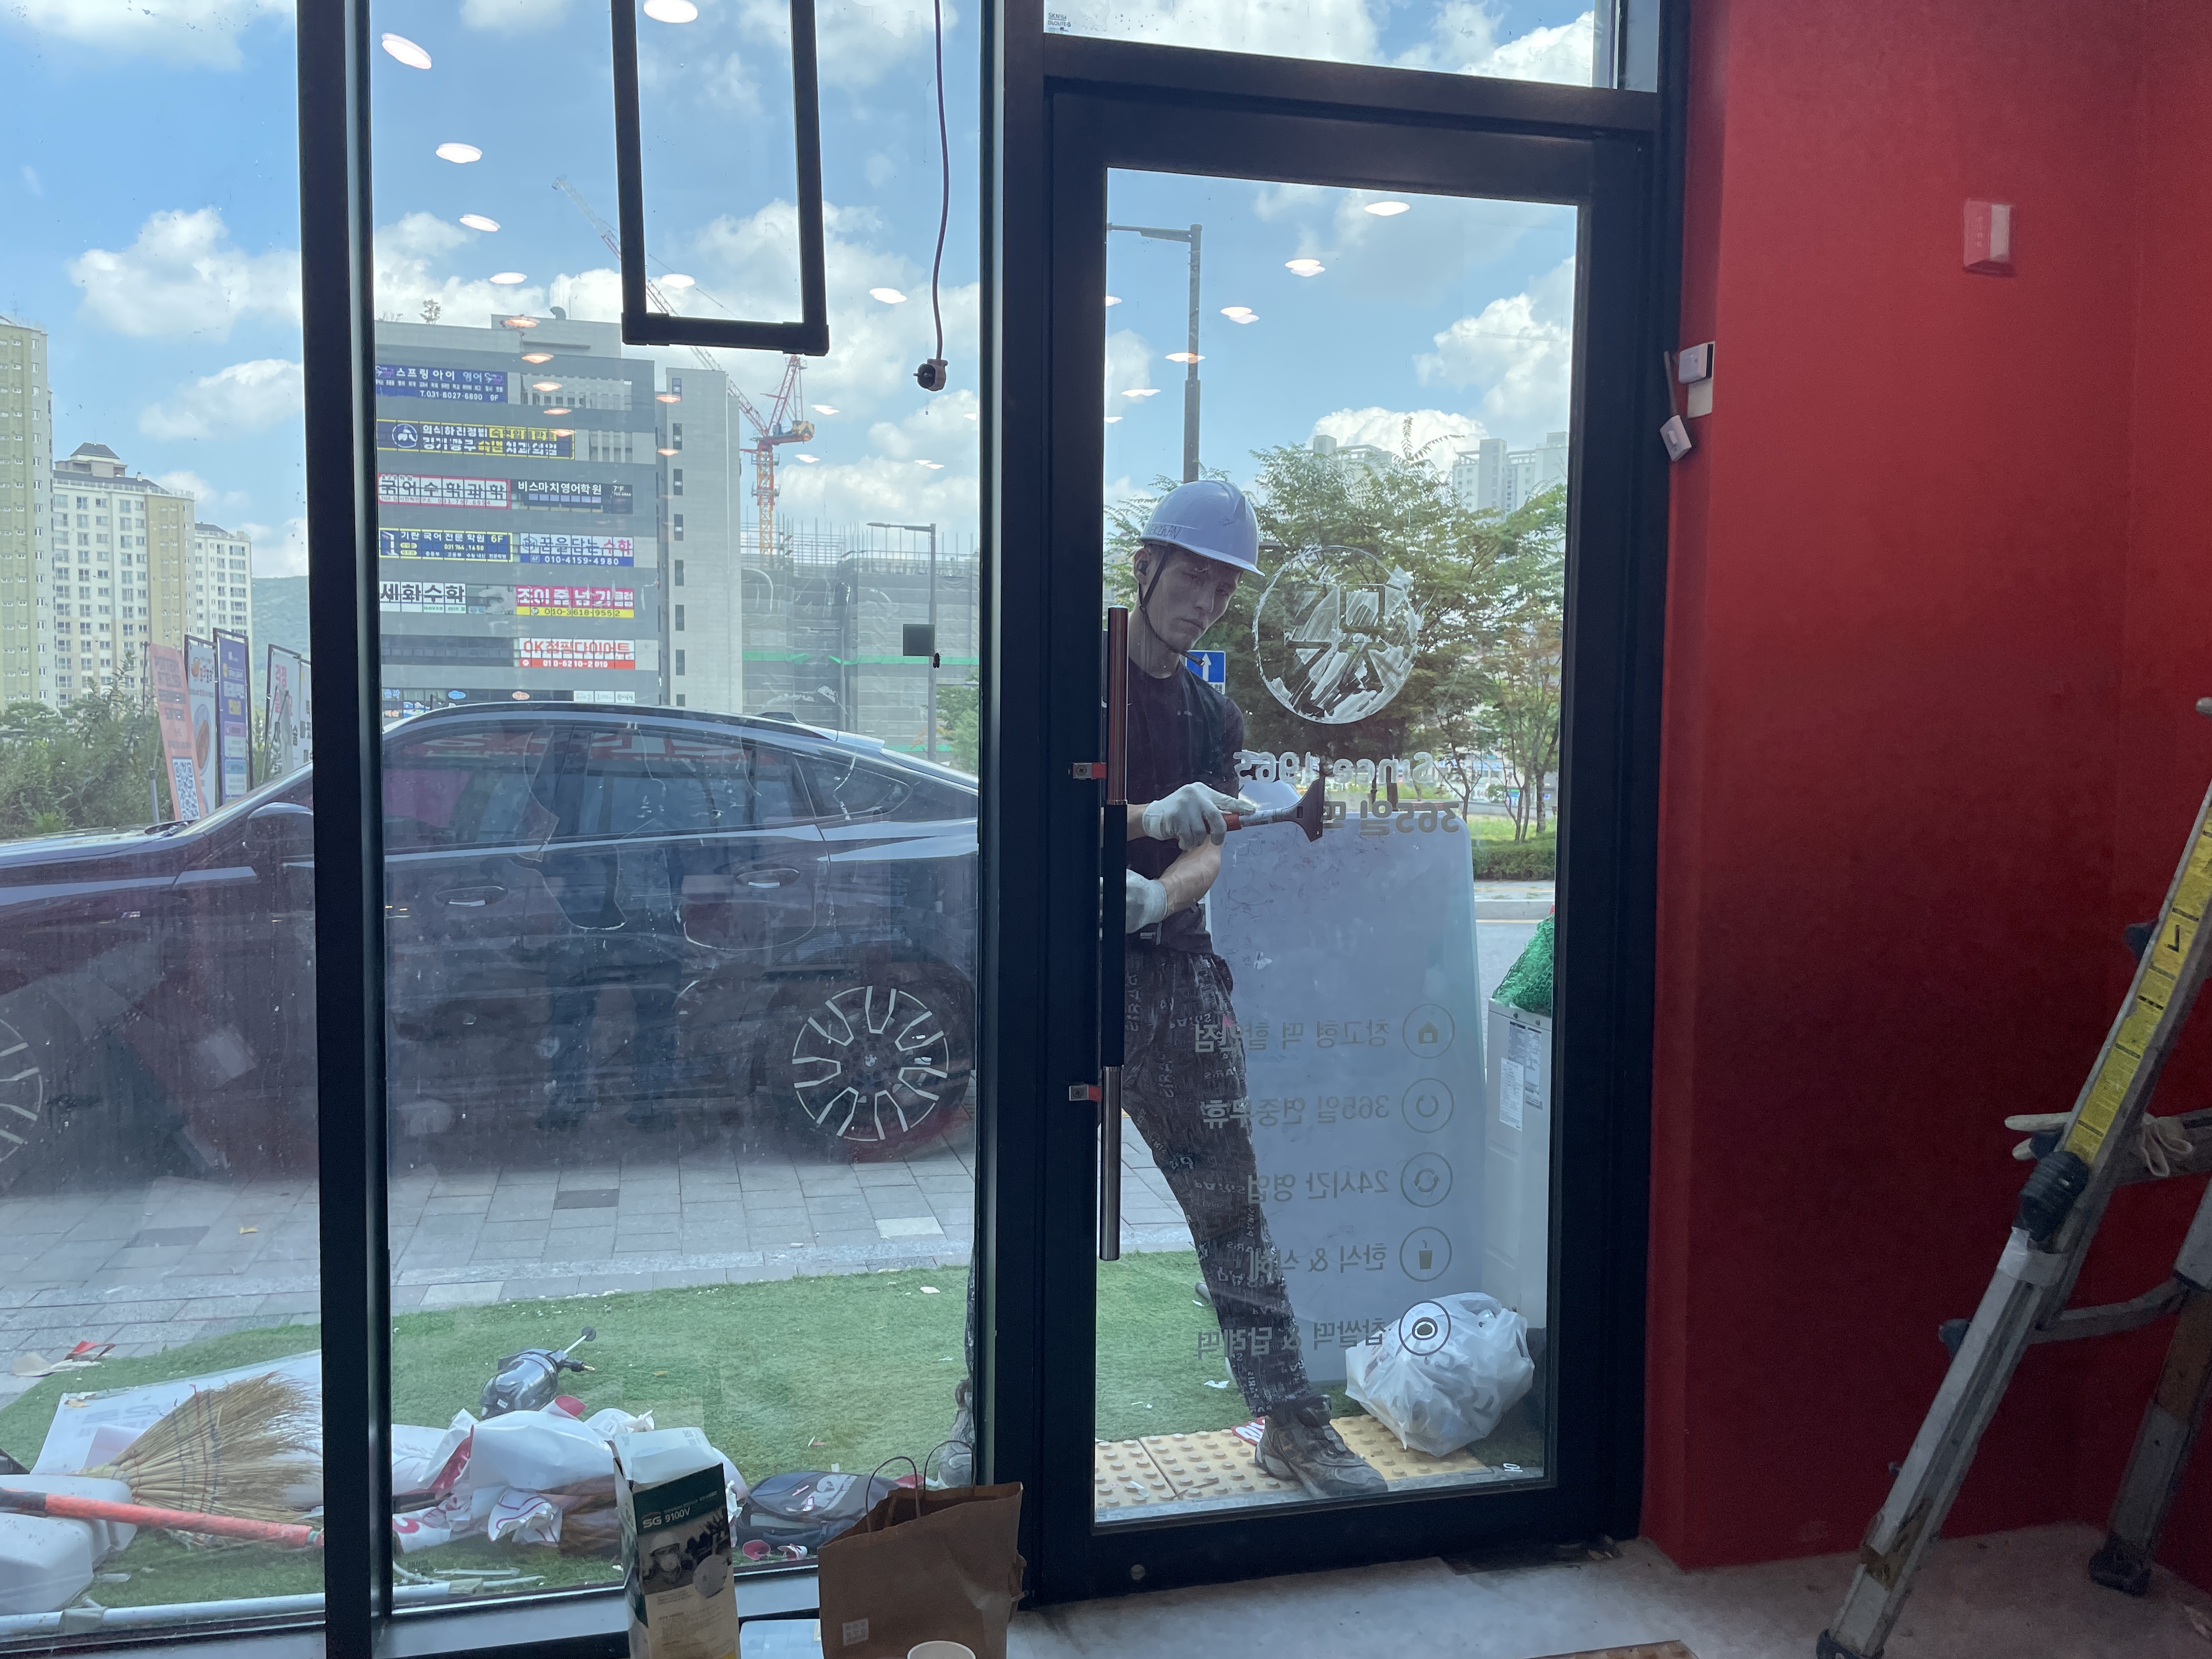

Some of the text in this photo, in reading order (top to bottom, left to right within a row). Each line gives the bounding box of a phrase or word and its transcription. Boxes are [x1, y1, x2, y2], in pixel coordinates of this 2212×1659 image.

[396, 368, 428, 380] 스프링
[432, 370, 454, 381] 아이
[462, 371, 482, 382] 영어
[518, 481, 601, 495] 비스마치영어학원
[424, 532, 441, 541] 국어
[490, 535, 503, 543] 6F
[603, 539, 631, 555] 수학
[545, 556, 619, 565] 010-4159-4980
[381, 583, 464, 603] 세화수학
[642, 1506, 691, 1528] SG 9100V
